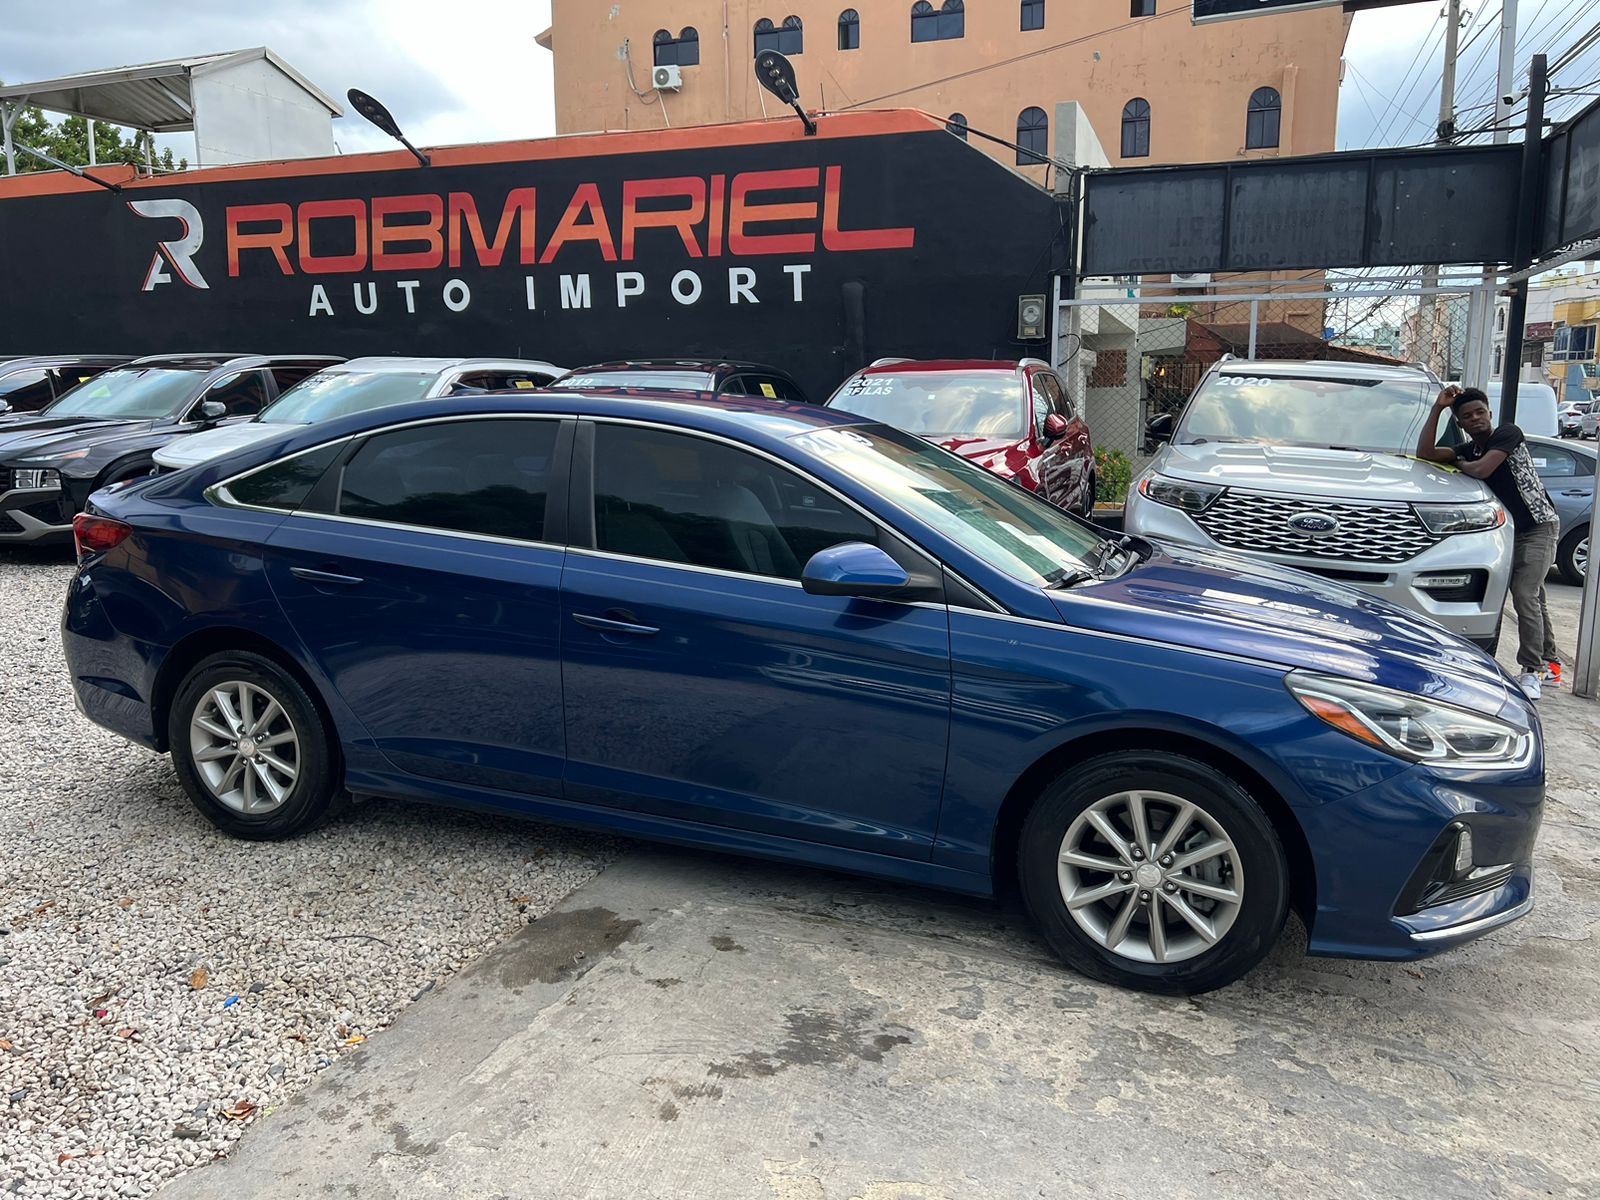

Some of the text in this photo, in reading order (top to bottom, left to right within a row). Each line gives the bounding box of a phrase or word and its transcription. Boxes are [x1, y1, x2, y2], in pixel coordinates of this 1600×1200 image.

[225, 165, 914, 277] ROBMARIEL
[309, 265, 811, 316] AUTO IMPORT
[850, 378, 894, 387] 2021
[1216, 376, 1272, 387] 2020
[843, 386, 893, 396] 3FILAS
